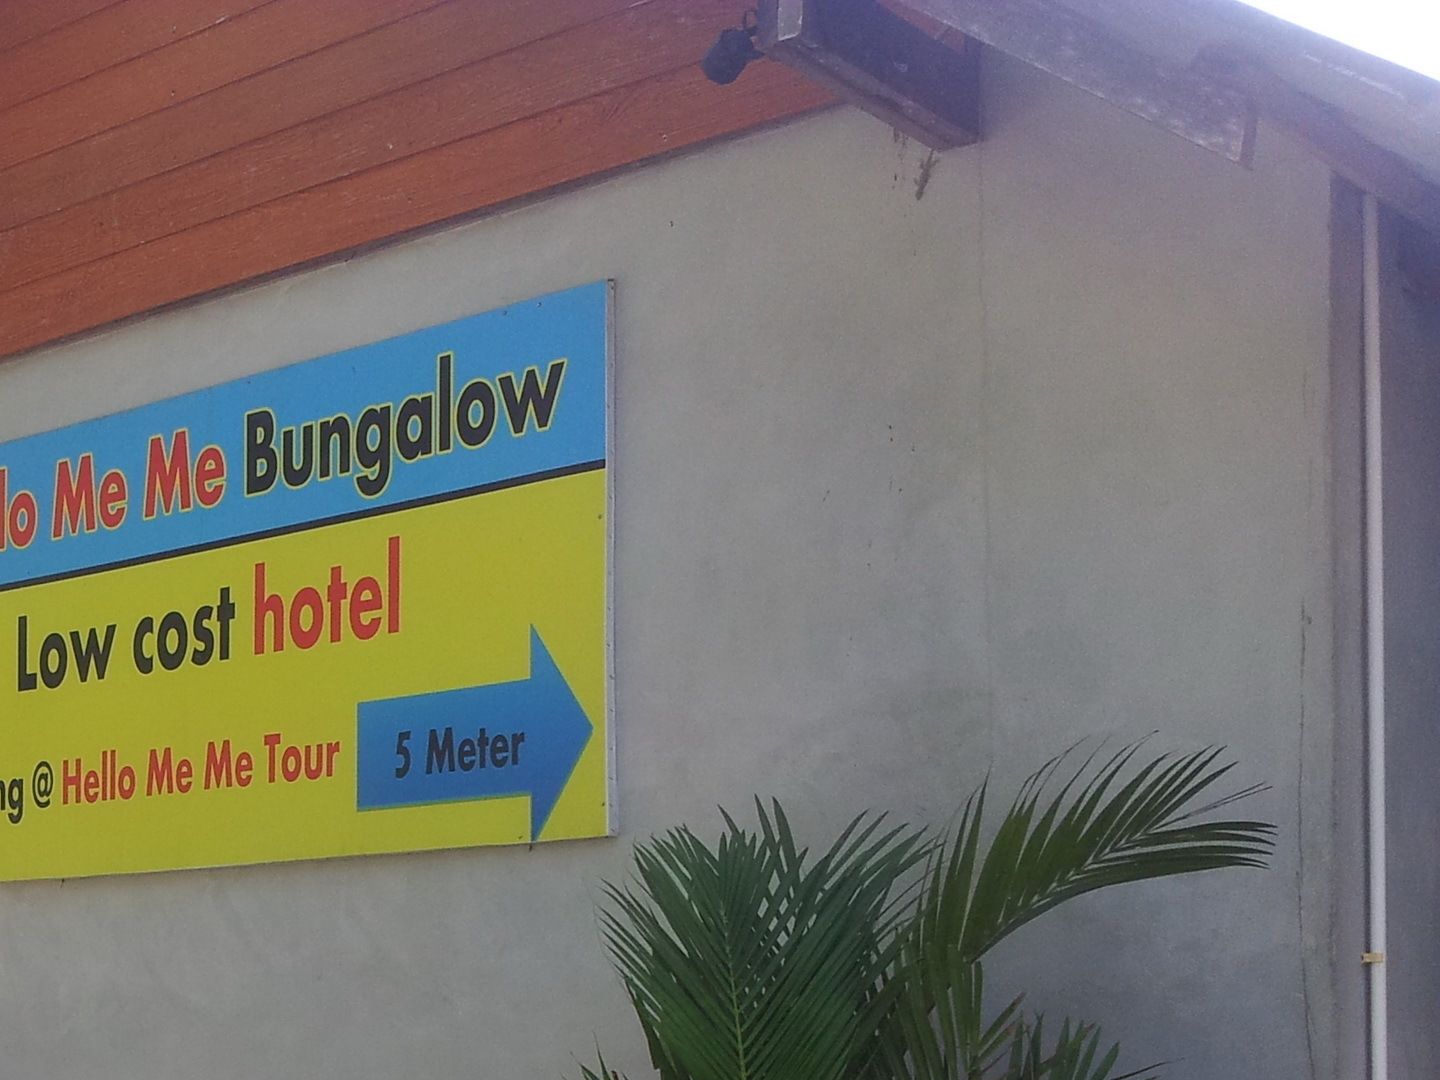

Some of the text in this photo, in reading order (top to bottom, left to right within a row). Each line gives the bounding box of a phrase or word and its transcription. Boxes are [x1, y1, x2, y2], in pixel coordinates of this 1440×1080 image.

[51, 452, 128, 539] Me
[143, 428, 227, 520] Me
[245, 351, 567, 498] Bungalow
[17, 535, 400, 692] Low cost hotel
[62, 749, 136, 805] Hello
[146, 747, 194, 797] Me
[204, 739, 253, 790] Me
[264, 732, 340, 784] Tour
[395, 726, 525, 779] 5 Meter
